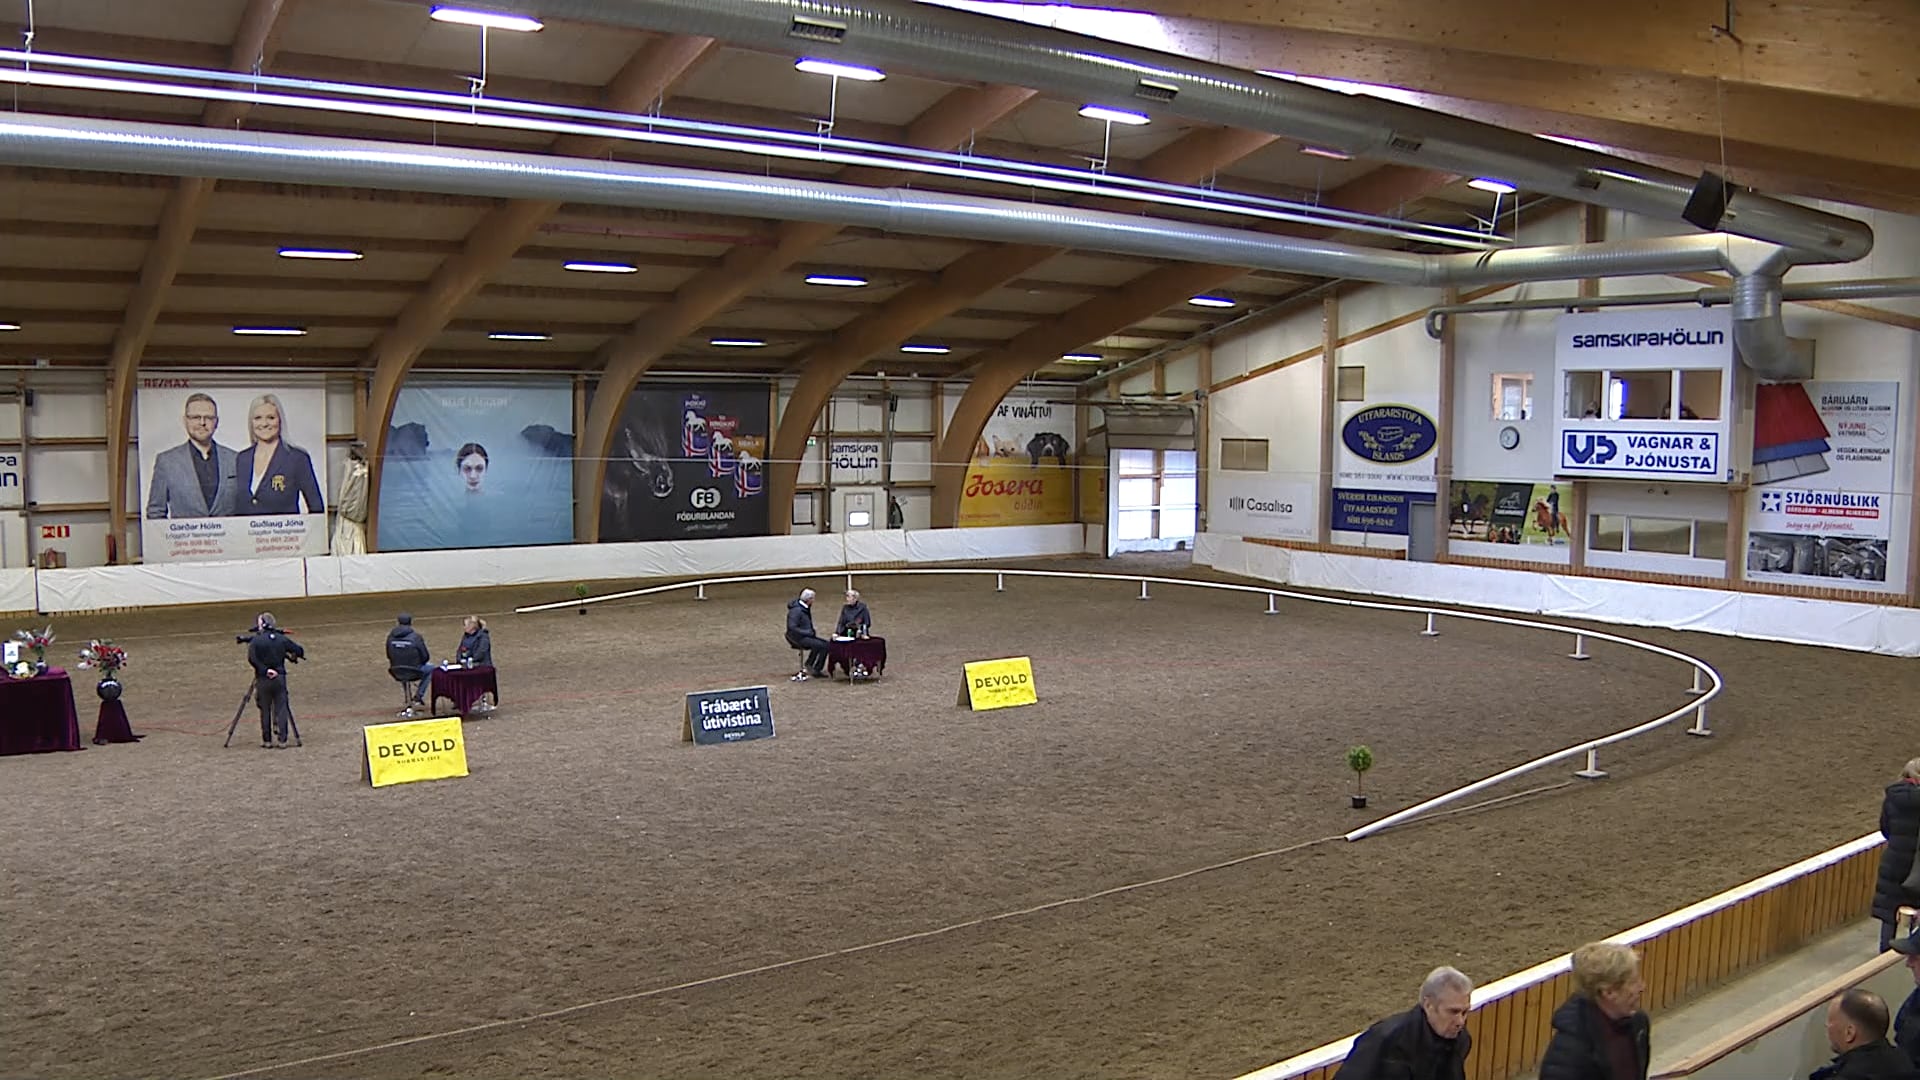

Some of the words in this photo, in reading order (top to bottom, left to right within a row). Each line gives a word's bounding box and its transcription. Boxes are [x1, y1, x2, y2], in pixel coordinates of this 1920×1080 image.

[143, 378, 190, 388] RE/MAX
[997, 405, 1009, 417] AF
[1627, 436, 1693, 450] VAGNAR
[1699, 437, 1711, 450] &
[1625, 452, 1711, 469] ÞJÓNUSTA
[966, 474, 1043, 498] Josera
[696, 491, 714, 504] FB
[1786, 490, 1879, 507] STJÖRNUBLIKK
[170, 523, 198, 531] Garðar
[250, 520, 283, 528] Guðlaug
[975, 673, 1028, 689] DEVOLD
[700, 698, 752, 715] Frábært
[702, 712, 761, 730] útivistina
[378, 738, 455, 758] DEVOLD
